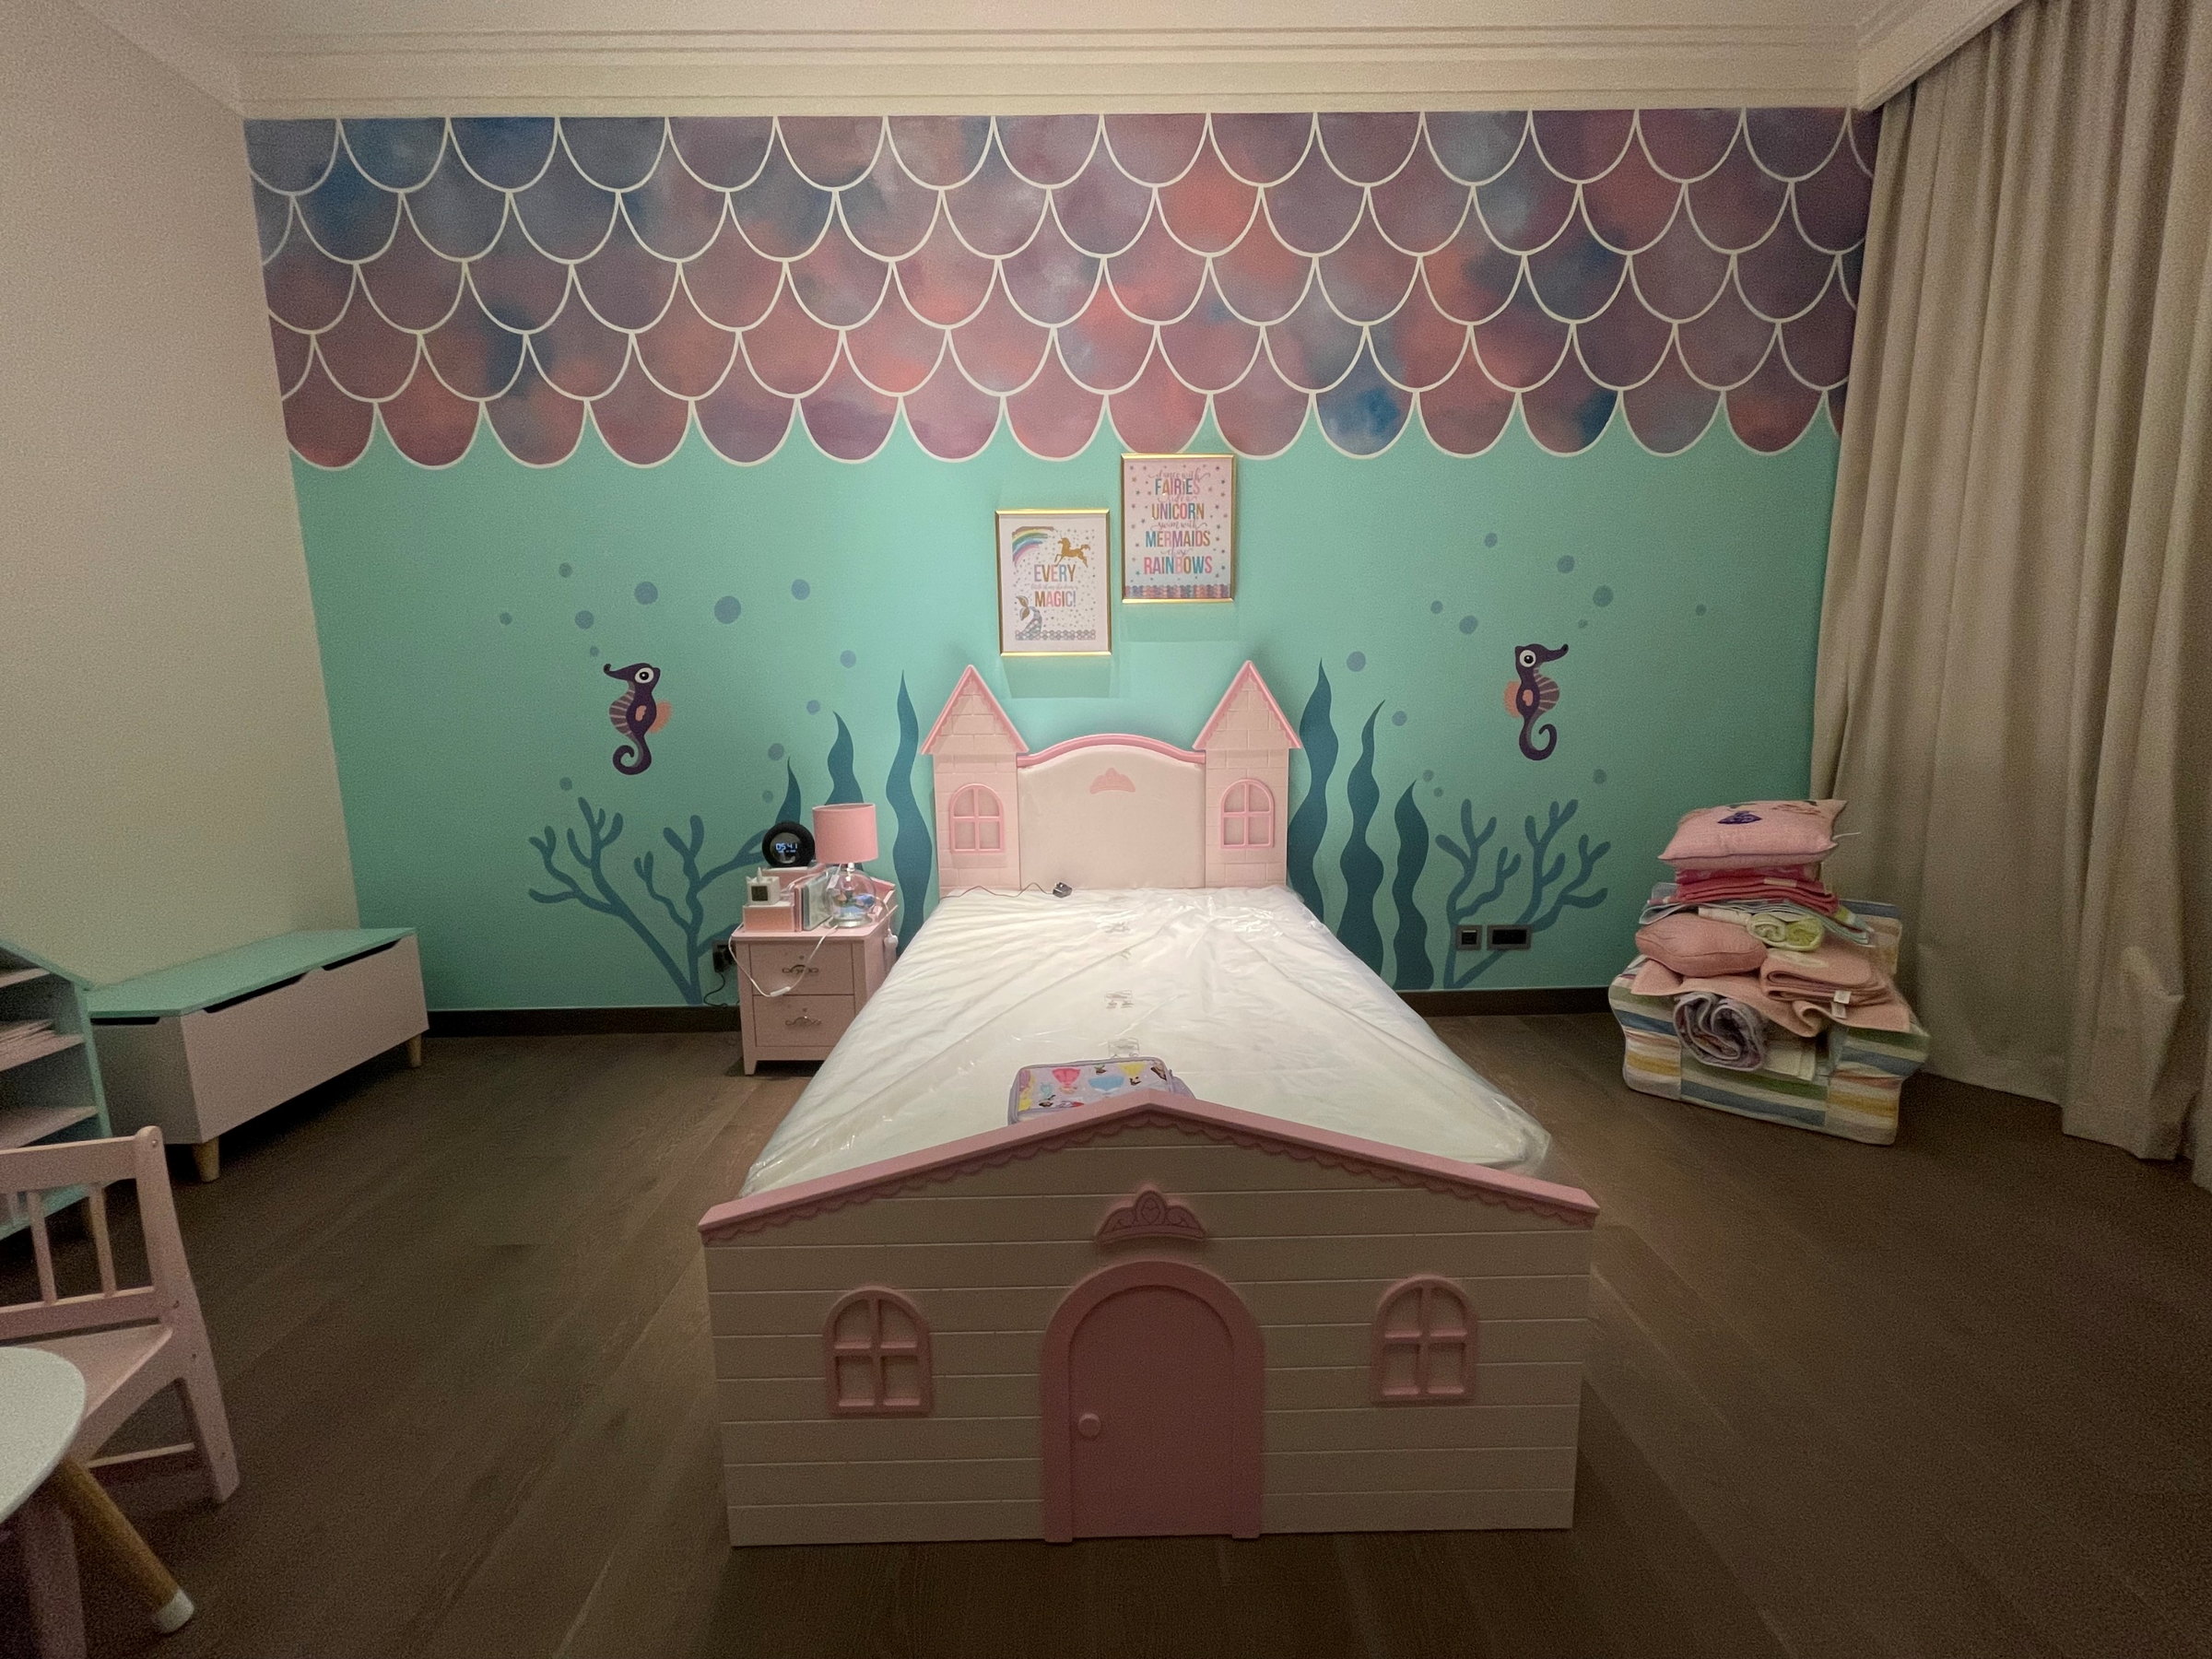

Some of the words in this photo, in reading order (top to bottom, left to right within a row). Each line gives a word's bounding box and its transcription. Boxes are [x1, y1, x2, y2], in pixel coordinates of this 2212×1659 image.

[1151, 502, 1205, 520] UNICORN
[1146, 530, 1211, 547] MERMAIDS
[1033, 563, 1077, 582] EVERY
[1144, 556, 1213, 574] RAINBOWS
[1034, 590, 1077, 608] MAGIC!
